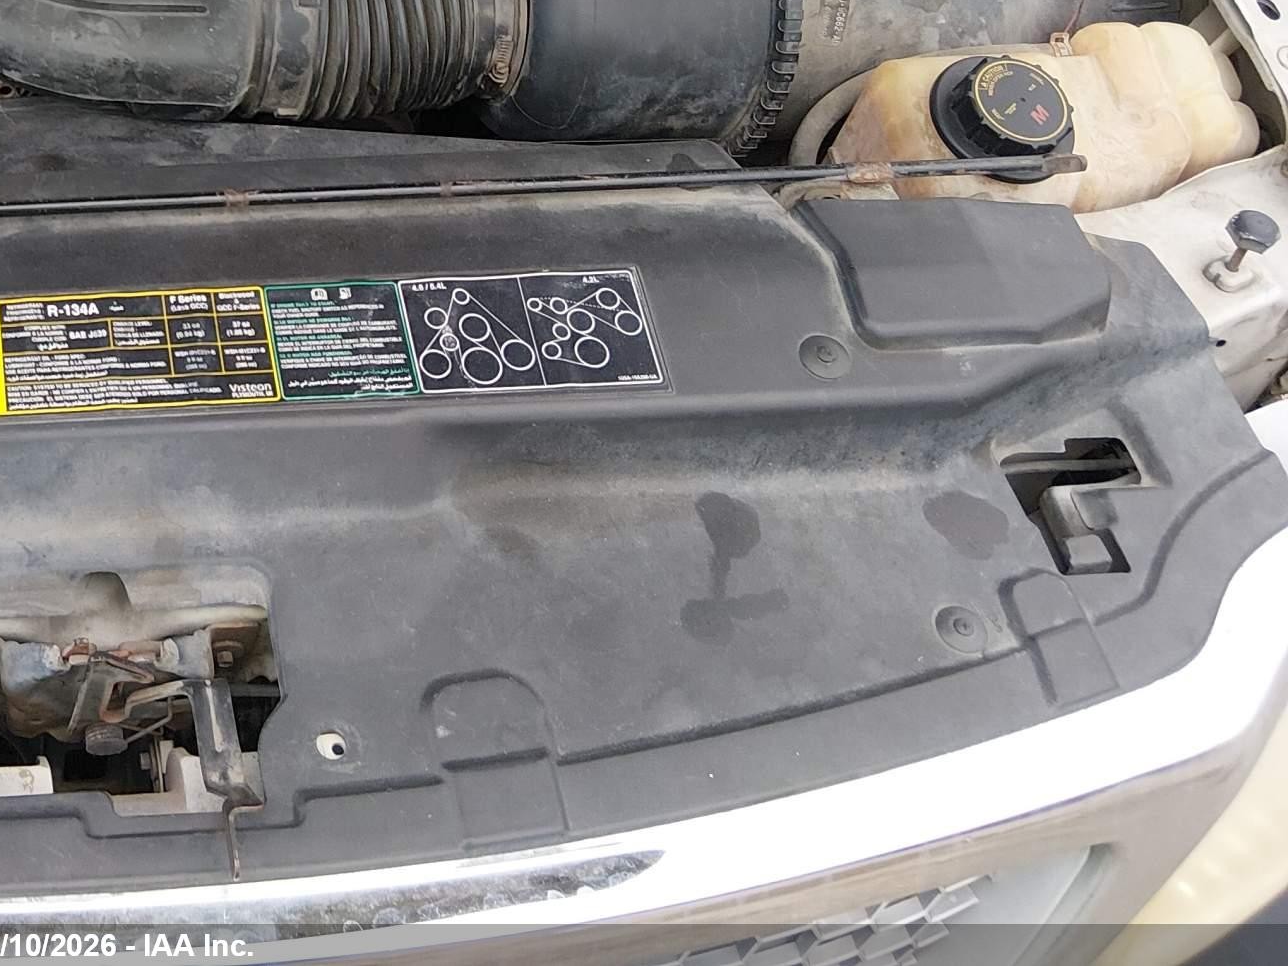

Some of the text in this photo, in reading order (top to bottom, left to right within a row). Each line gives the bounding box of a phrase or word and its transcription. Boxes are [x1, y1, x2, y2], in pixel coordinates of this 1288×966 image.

[177, 294, 208, 304] Series
[47, 302, 100, 319] R-134A
[229, 382, 273, 394] Visteon
